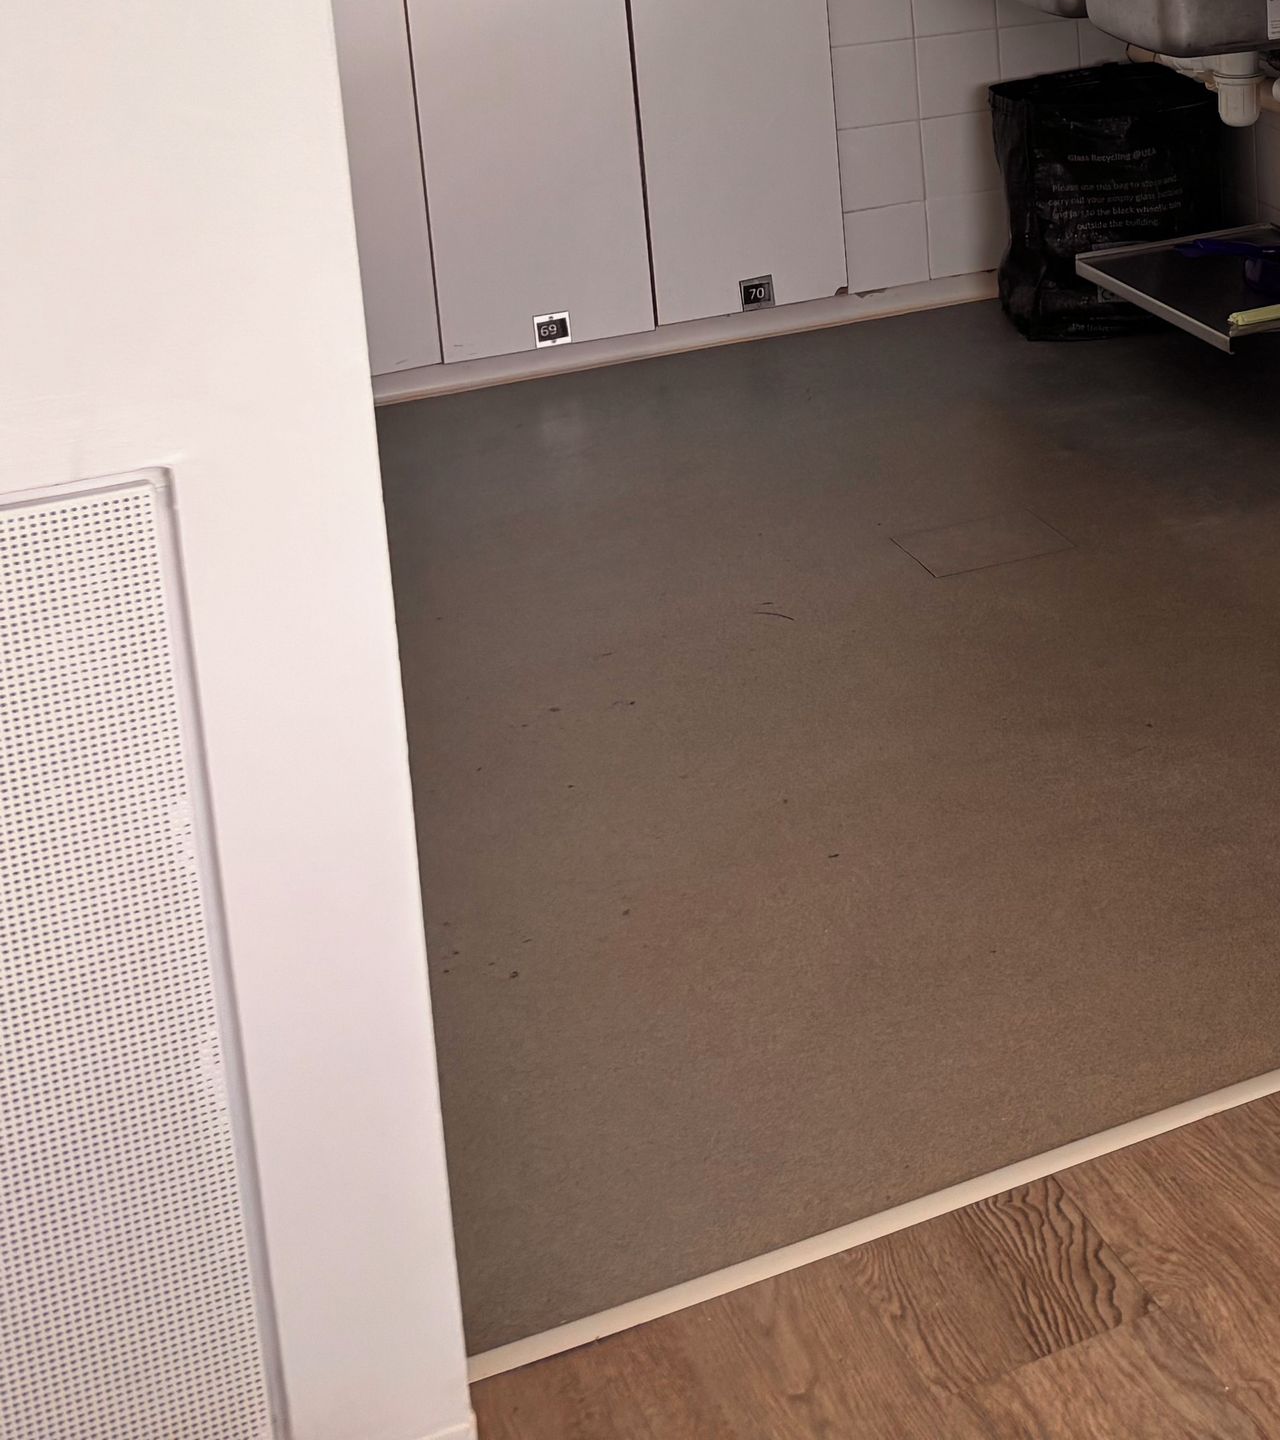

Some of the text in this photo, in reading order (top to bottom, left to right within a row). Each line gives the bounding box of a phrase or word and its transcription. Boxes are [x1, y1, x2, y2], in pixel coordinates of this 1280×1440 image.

[1067, 154, 1090, 162] Glass
[1052, 184, 1079, 193] Please
[749, 287, 765, 300] 70
[540, 324, 557, 337] 69
